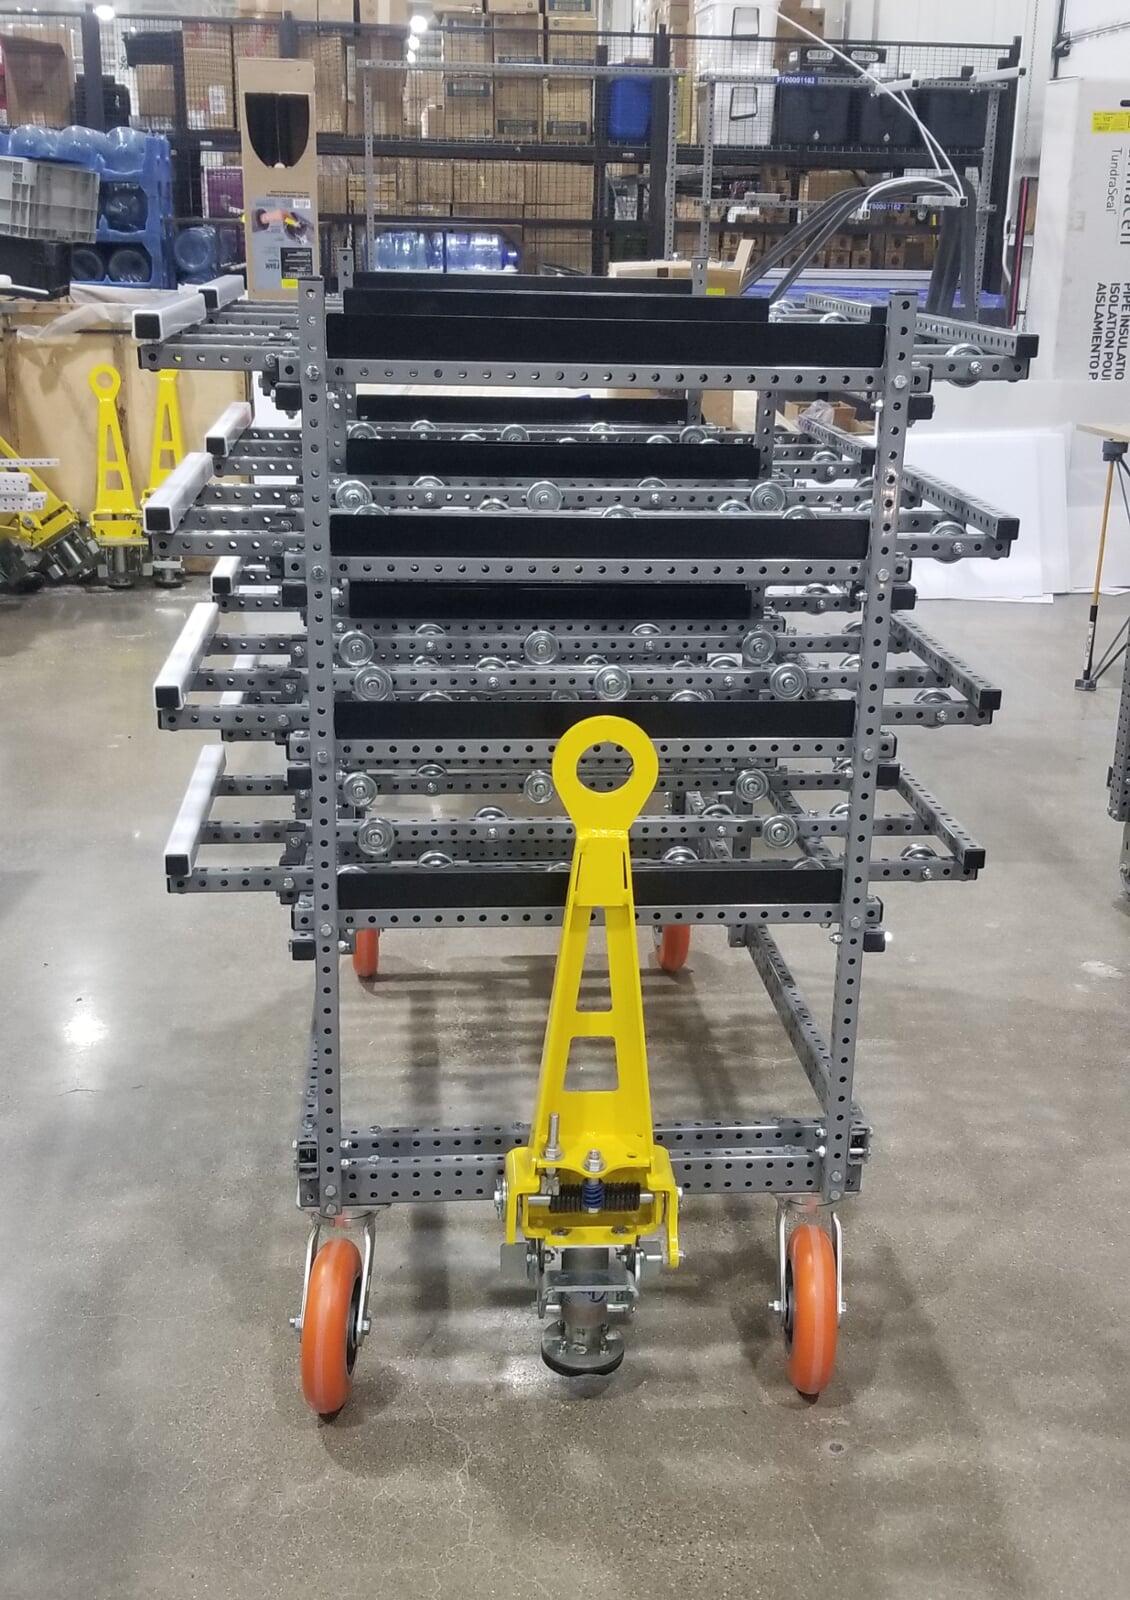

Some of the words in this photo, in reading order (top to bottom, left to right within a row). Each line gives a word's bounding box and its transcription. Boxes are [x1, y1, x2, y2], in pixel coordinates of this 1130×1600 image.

[1106, 148, 1122, 213] TundraSeal
[1089, 282, 1107, 369] AISLAMIENTO
[1104, 282, 1120, 349] ISOLATION
[1121, 282, 1130, 312] PIPE
[1101, 351, 1114, 380] POU
[1114, 314, 1130, 380] INSULATIO
